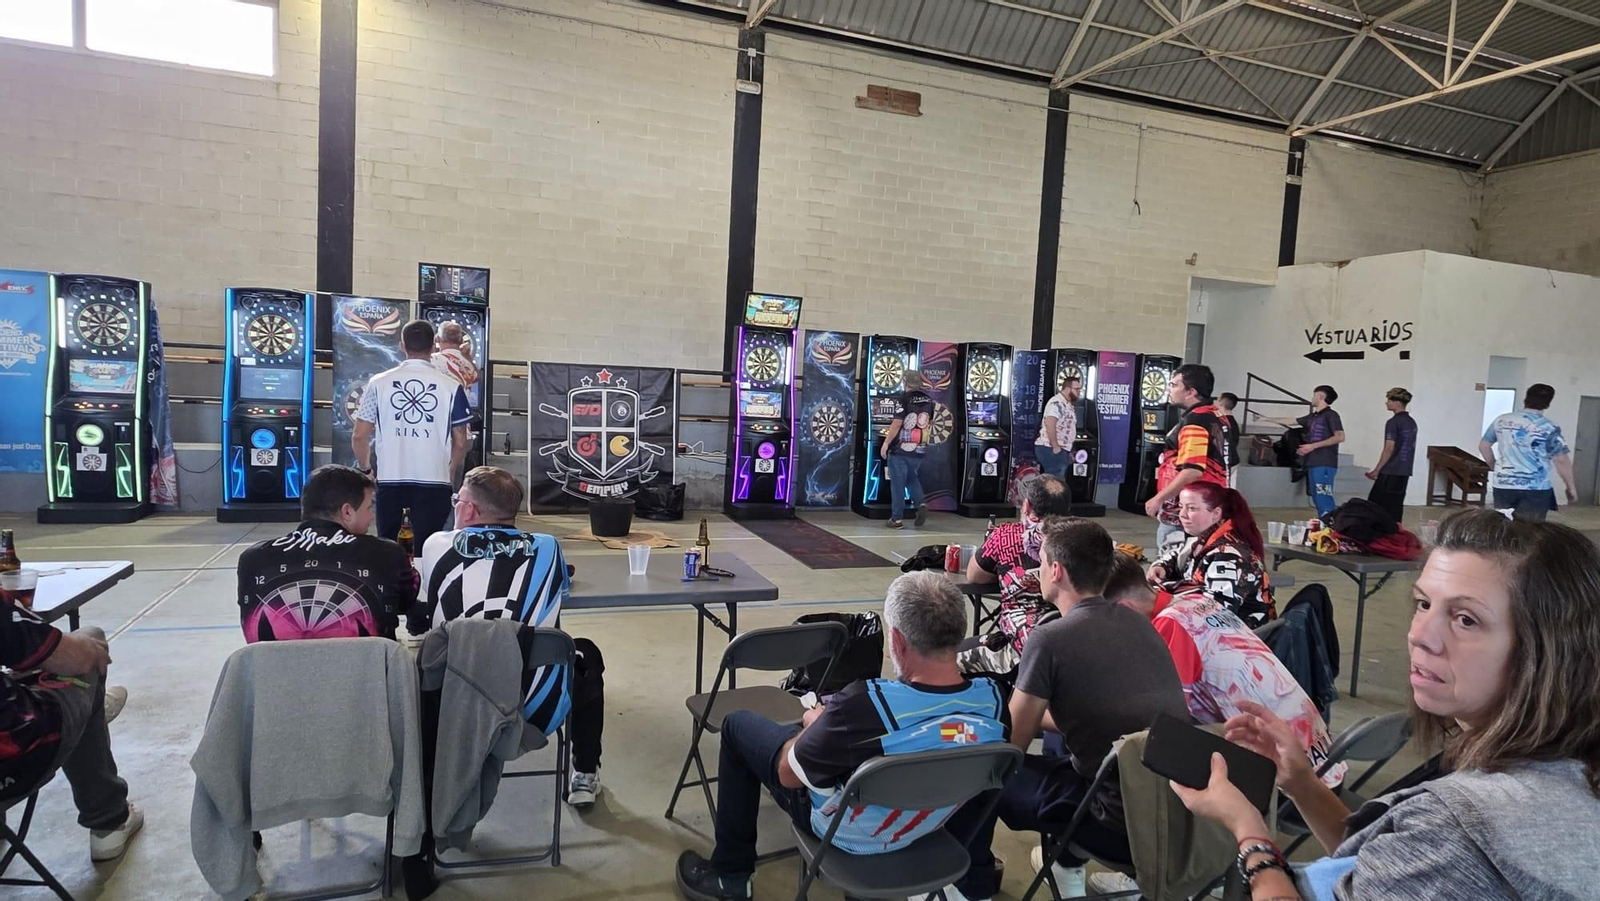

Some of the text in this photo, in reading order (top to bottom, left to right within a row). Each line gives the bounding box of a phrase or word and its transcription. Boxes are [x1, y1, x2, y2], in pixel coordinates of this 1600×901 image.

[353, 304, 391, 314] PHOENIX
[1026, 355, 1038, 365] 20
[1024, 385, 1036, 396] 18
[1098, 383, 1130, 395] PHOENIX
[1097, 393, 1129, 405] SUMMER
[1023, 400, 1035, 410] 17
[1097, 403, 1128, 415] FESTIVAL
[1146, 413, 1157, 423] 13
[395, 427, 432, 439] RIKY
[279, 564, 287, 573] 5
[304, 559, 319, 568] 20
[336, 561, 342, 569] 1
[357, 569, 370, 578] 18
[254, 575, 266, 586] 12
[377, 584, 384, 593] 4
